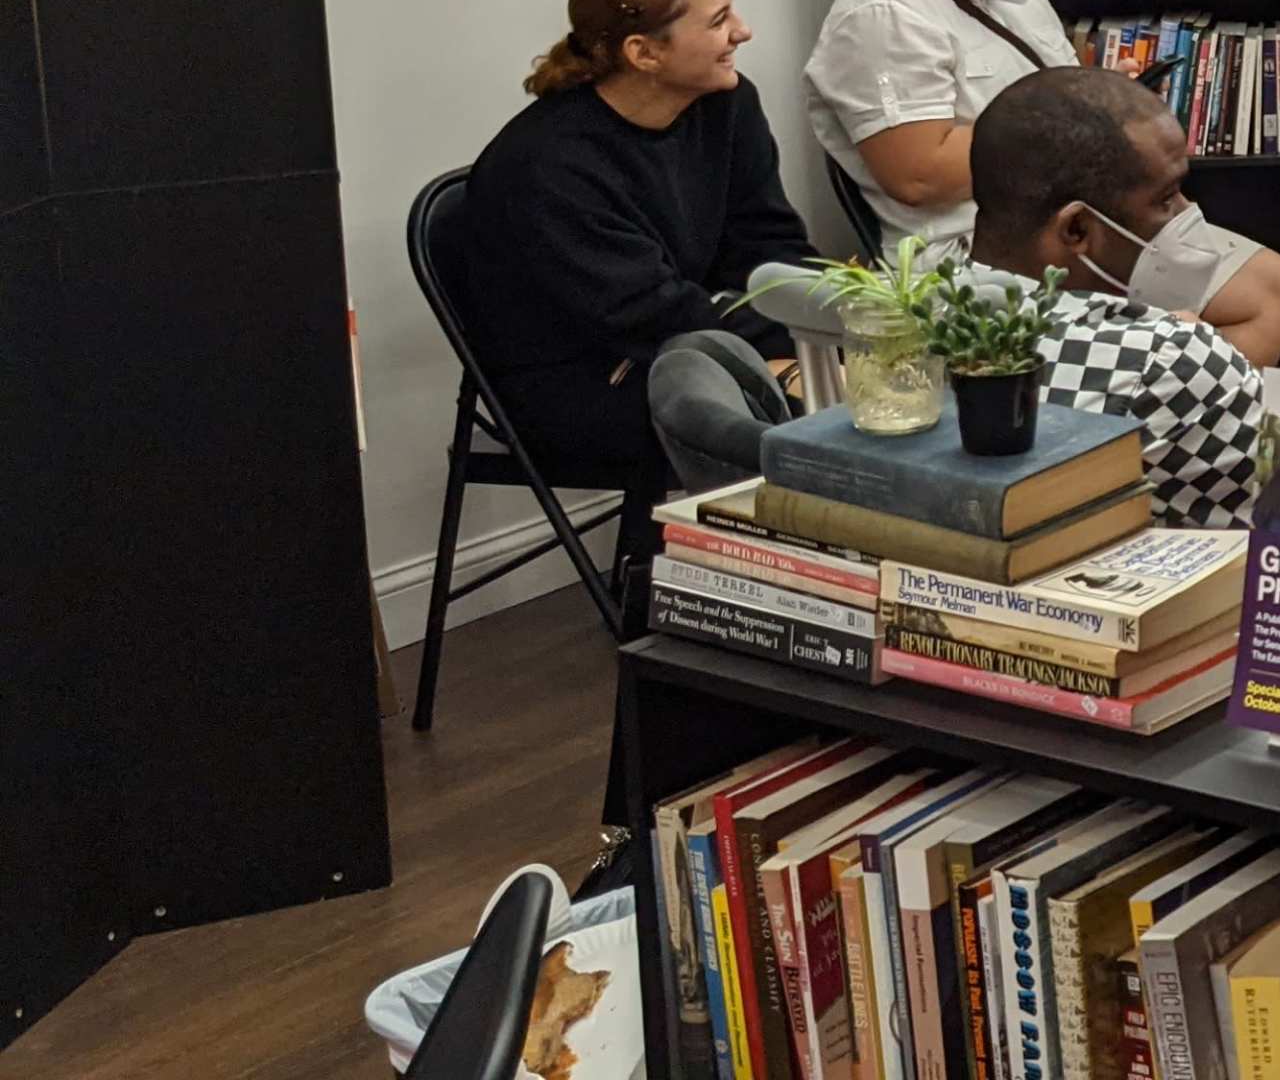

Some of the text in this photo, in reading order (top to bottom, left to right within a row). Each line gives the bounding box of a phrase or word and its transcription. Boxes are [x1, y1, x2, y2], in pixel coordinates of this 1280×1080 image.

[713, 572, 764, 598] TERKEL
[898, 567, 1104, 633] The Permanent War Economy
[898, 588, 977, 616] Seymour Melman
[653, 590, 786, 634] Free Speech and the Suppression
[657, 610, 667, 624] of
[669, 611, 700, 630] Dissent
[700, 619, 728, 640] during
[728, 624, 755, 644] World
[754, 633, 773, 650] War
[1255, 611, 1262, 621] A
[1255, 623, 1269, 636] The
[793, 645, 841, 667] CHEST
[900, 631, 997, 670] REVOLUTIONARY
[1252, 649, 1266, 661] The
[1253, 637, 1264, 649] for
[961, 677, 998, 692] BLACKS
[759, 908, 772, 941] AND
[771, 903, 794, 965] The SUN
[911, 914, 924, 955] Imperial
[1009, 886, 1038, 1017] MOSCOW
[763, 946, 781, 1013] CLASSIFY
[848, 943, 869, 1030] BATTLE LINES
[1155, 971, 1183, 1007] EPIC
[1257, 1007, 1272, 1064] EDWARD
